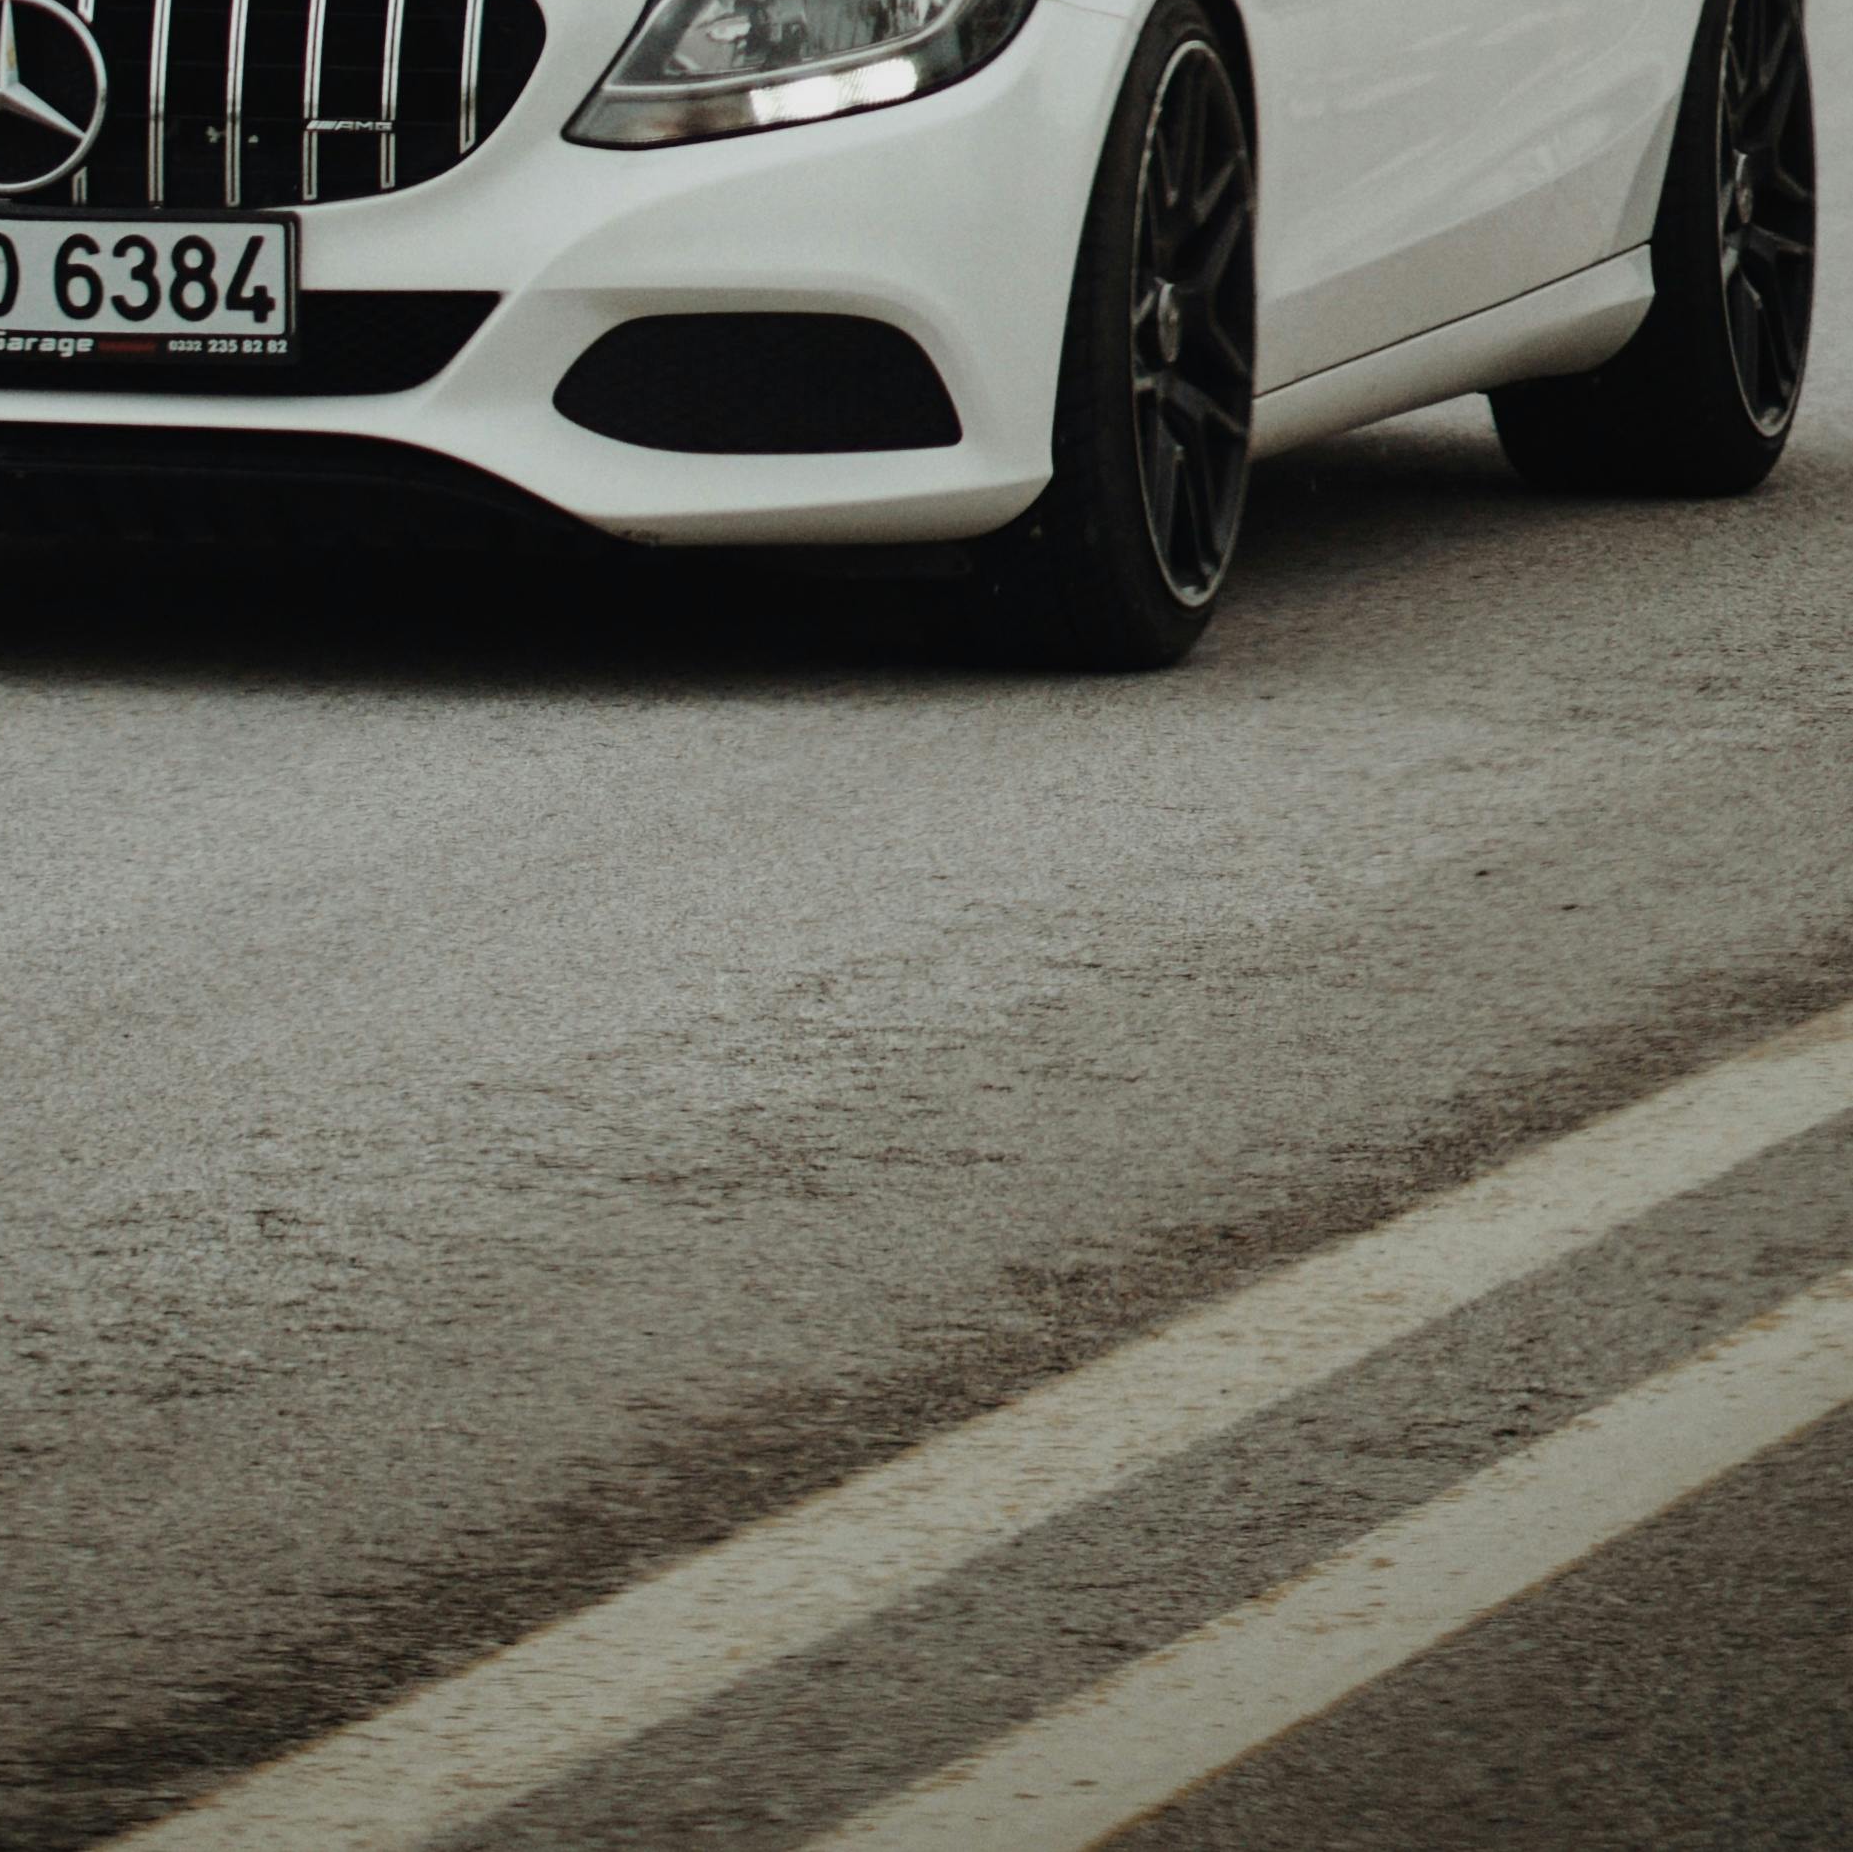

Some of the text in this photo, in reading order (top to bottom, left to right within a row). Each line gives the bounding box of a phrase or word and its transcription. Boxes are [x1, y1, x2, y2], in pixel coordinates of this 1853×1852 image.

[334, 120, 393, 131] AMG
[53, 232, 277, 323] 6384
[168, 339, 288, 354] 0332 235 82 82
